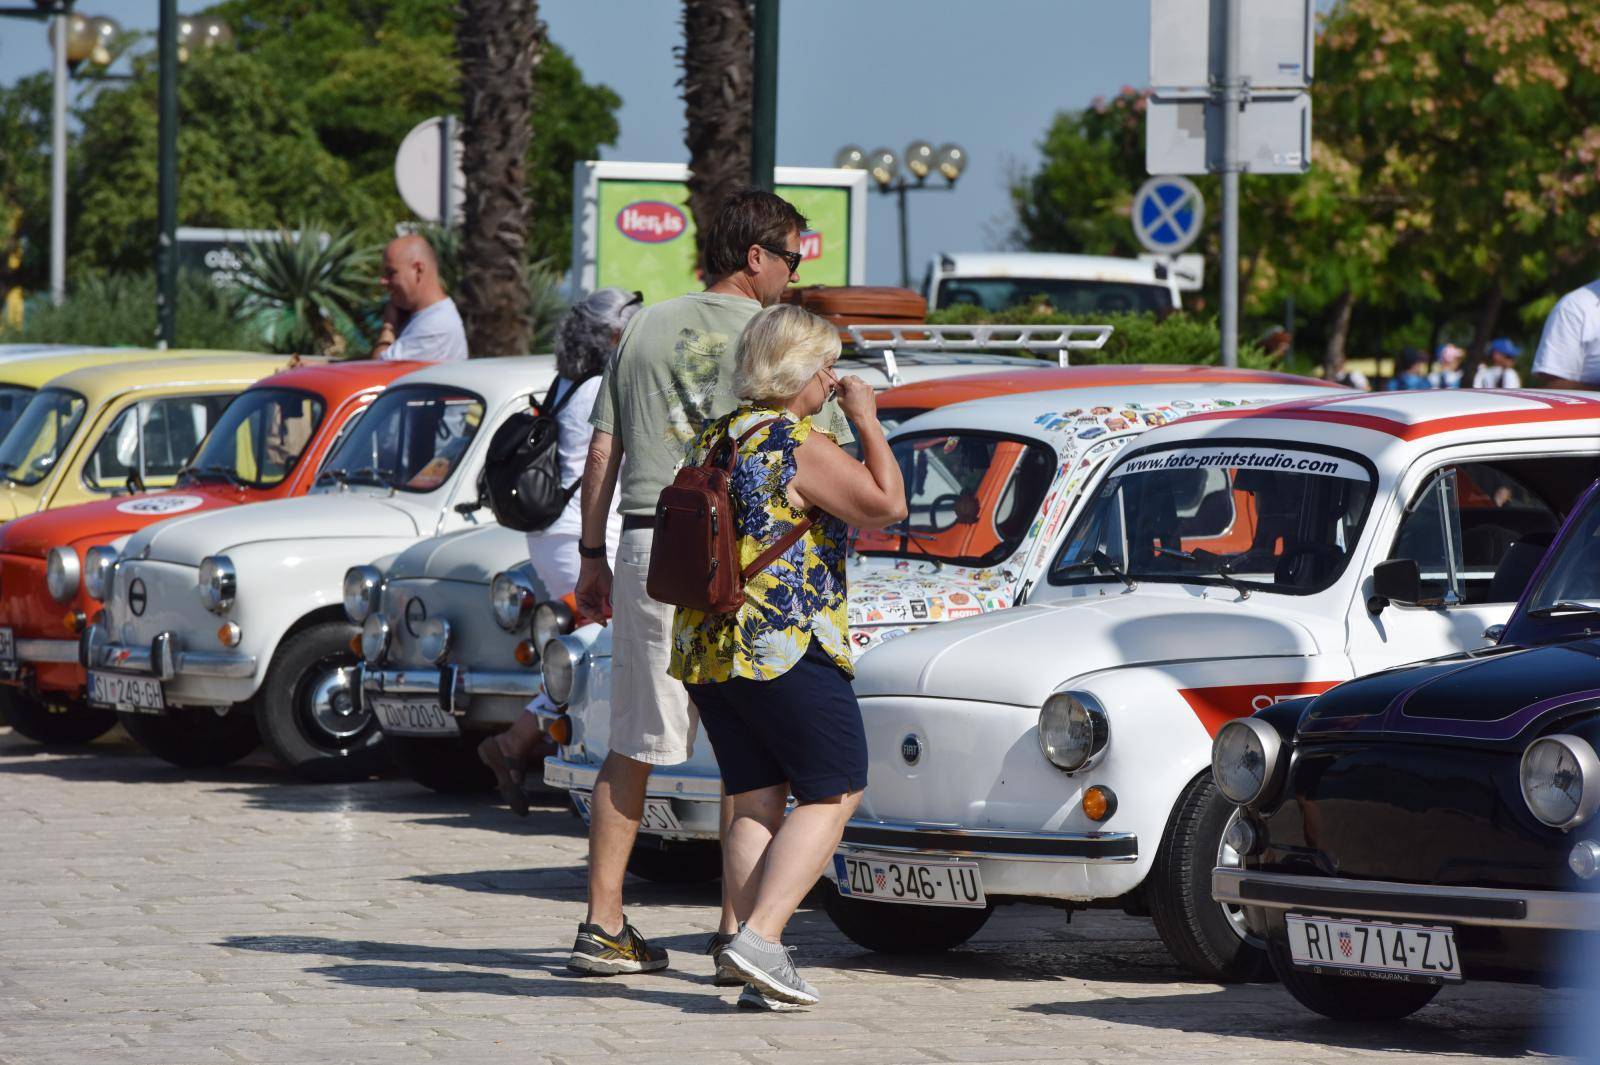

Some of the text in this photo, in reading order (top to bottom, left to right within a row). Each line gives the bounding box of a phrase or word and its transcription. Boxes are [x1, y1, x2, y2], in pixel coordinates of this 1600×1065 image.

[623, 208, 683, 235] Hervis
[1126, 451, 1340, 474] www.foto-printstudio.com
[903, 743, 918, 755] FIAT
[846, 859, 978, 902] ZD 346-IU
[1304, 922, 1454, 972] RI 714-ZJ
